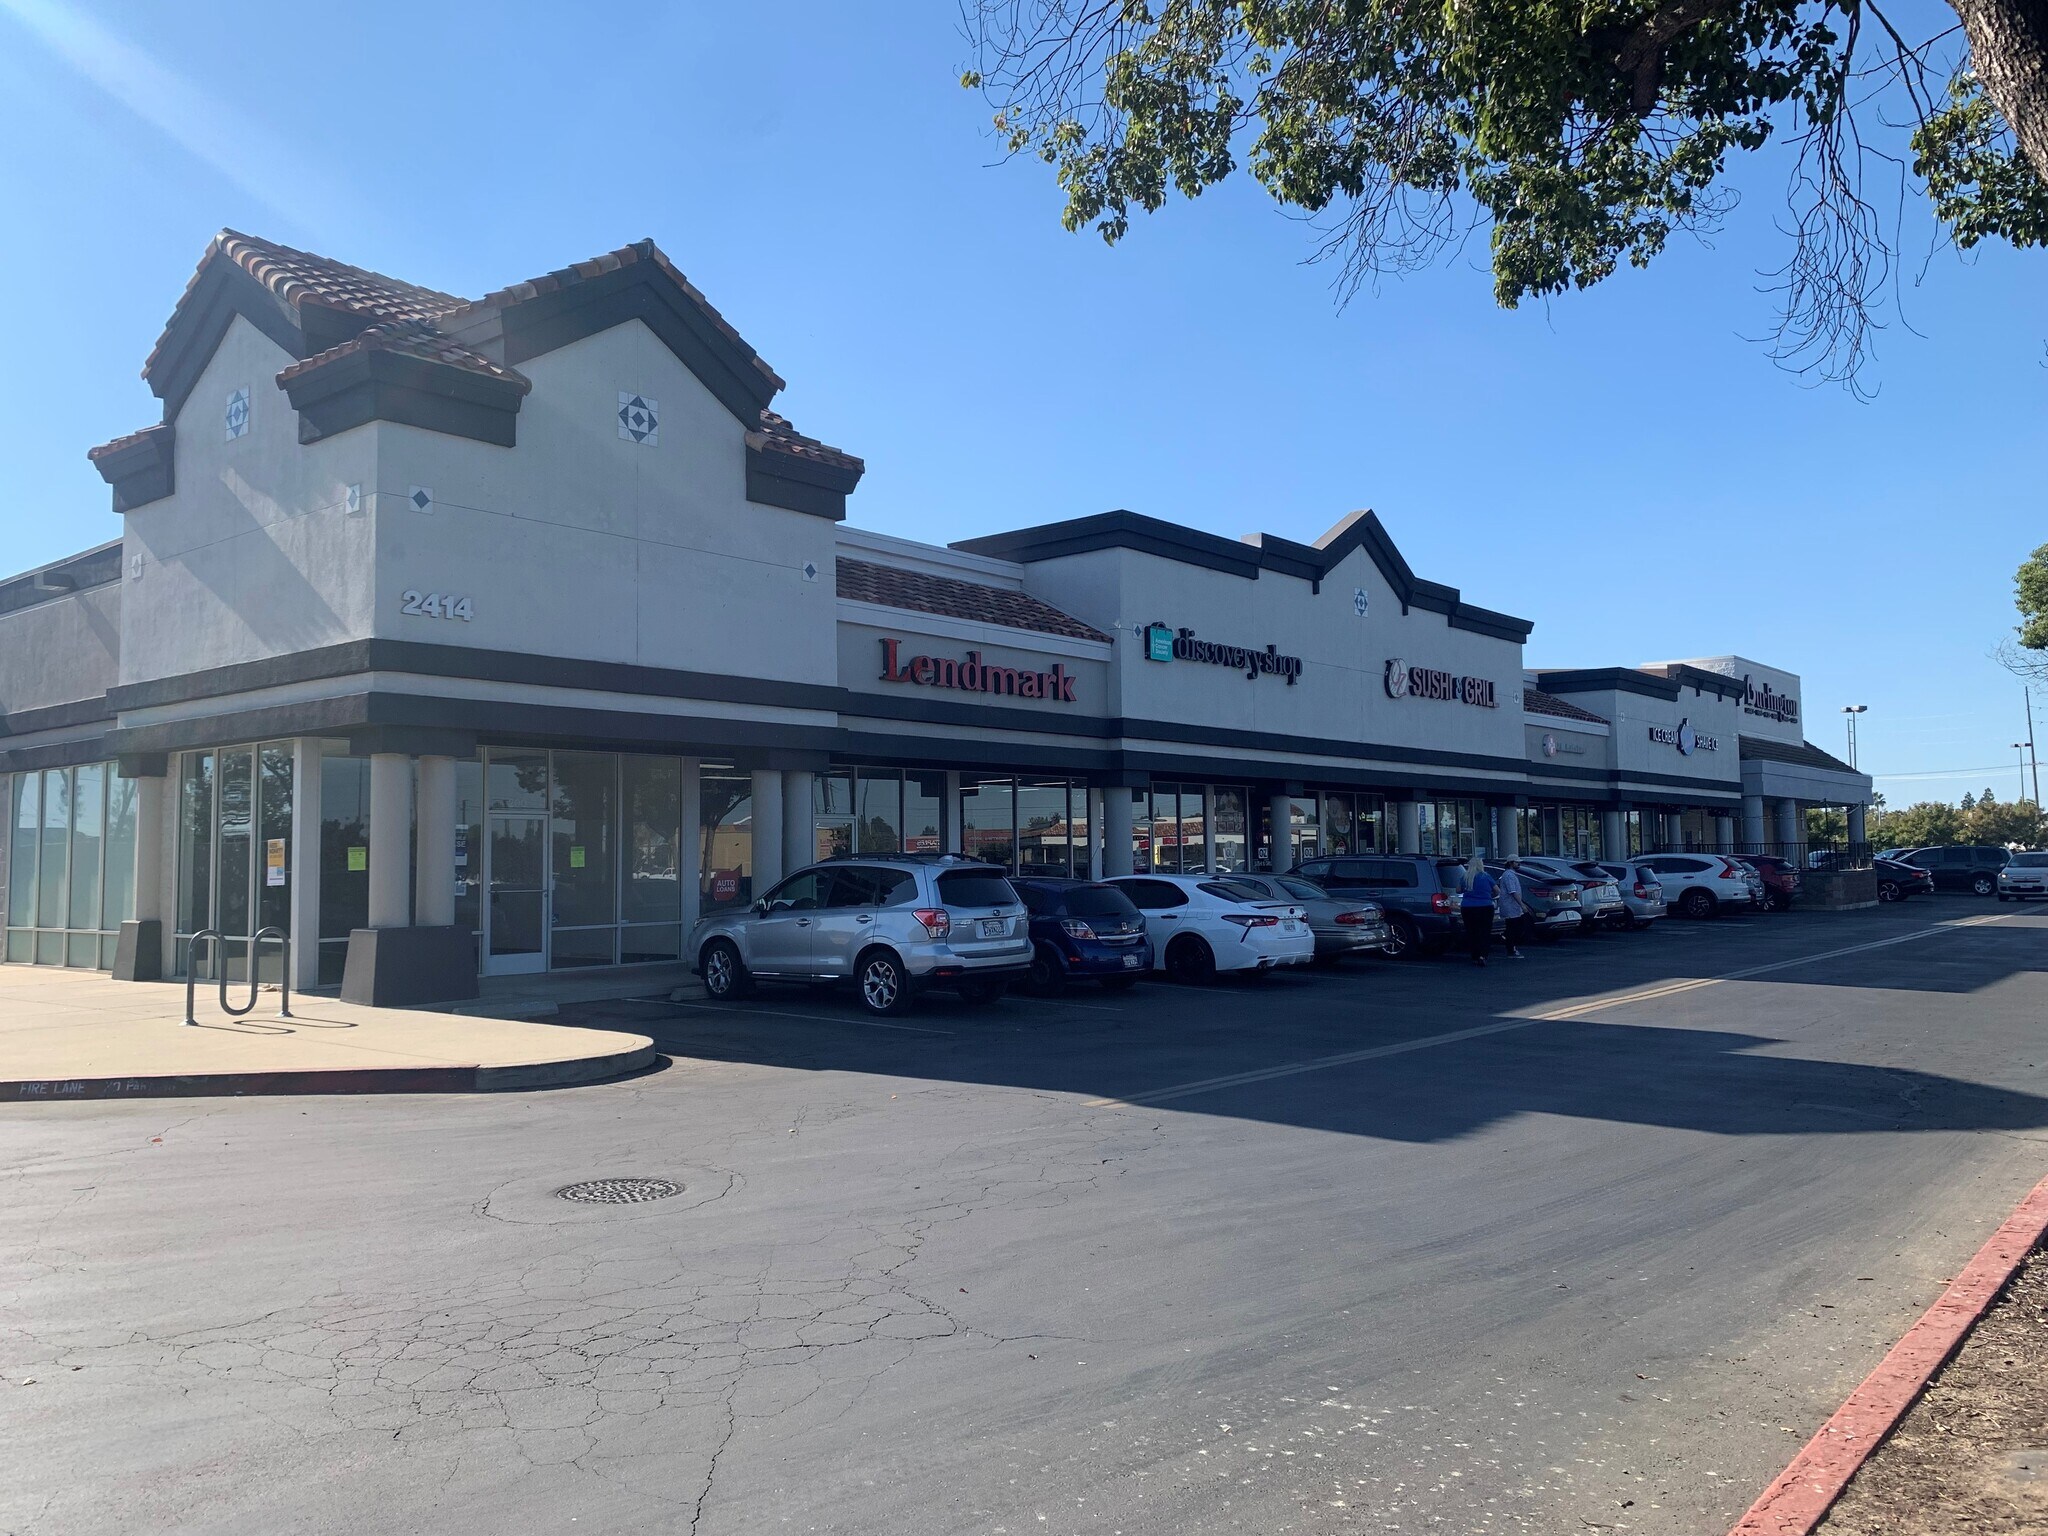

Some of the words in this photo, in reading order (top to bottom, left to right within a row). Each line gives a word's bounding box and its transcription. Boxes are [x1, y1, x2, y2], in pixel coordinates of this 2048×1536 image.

[400, 589, 474, 622] 2414
[878, 637, 1078, 702] Lendmark
[1409, 666, 1453, 701] SUSHI
[1462, 676, 1500, 708] GRILL
[716, 879, 735, 887] AUTO
[19, 1081, 48, 1094] FIRE
[53, 1080, 86, 1094] LANE
